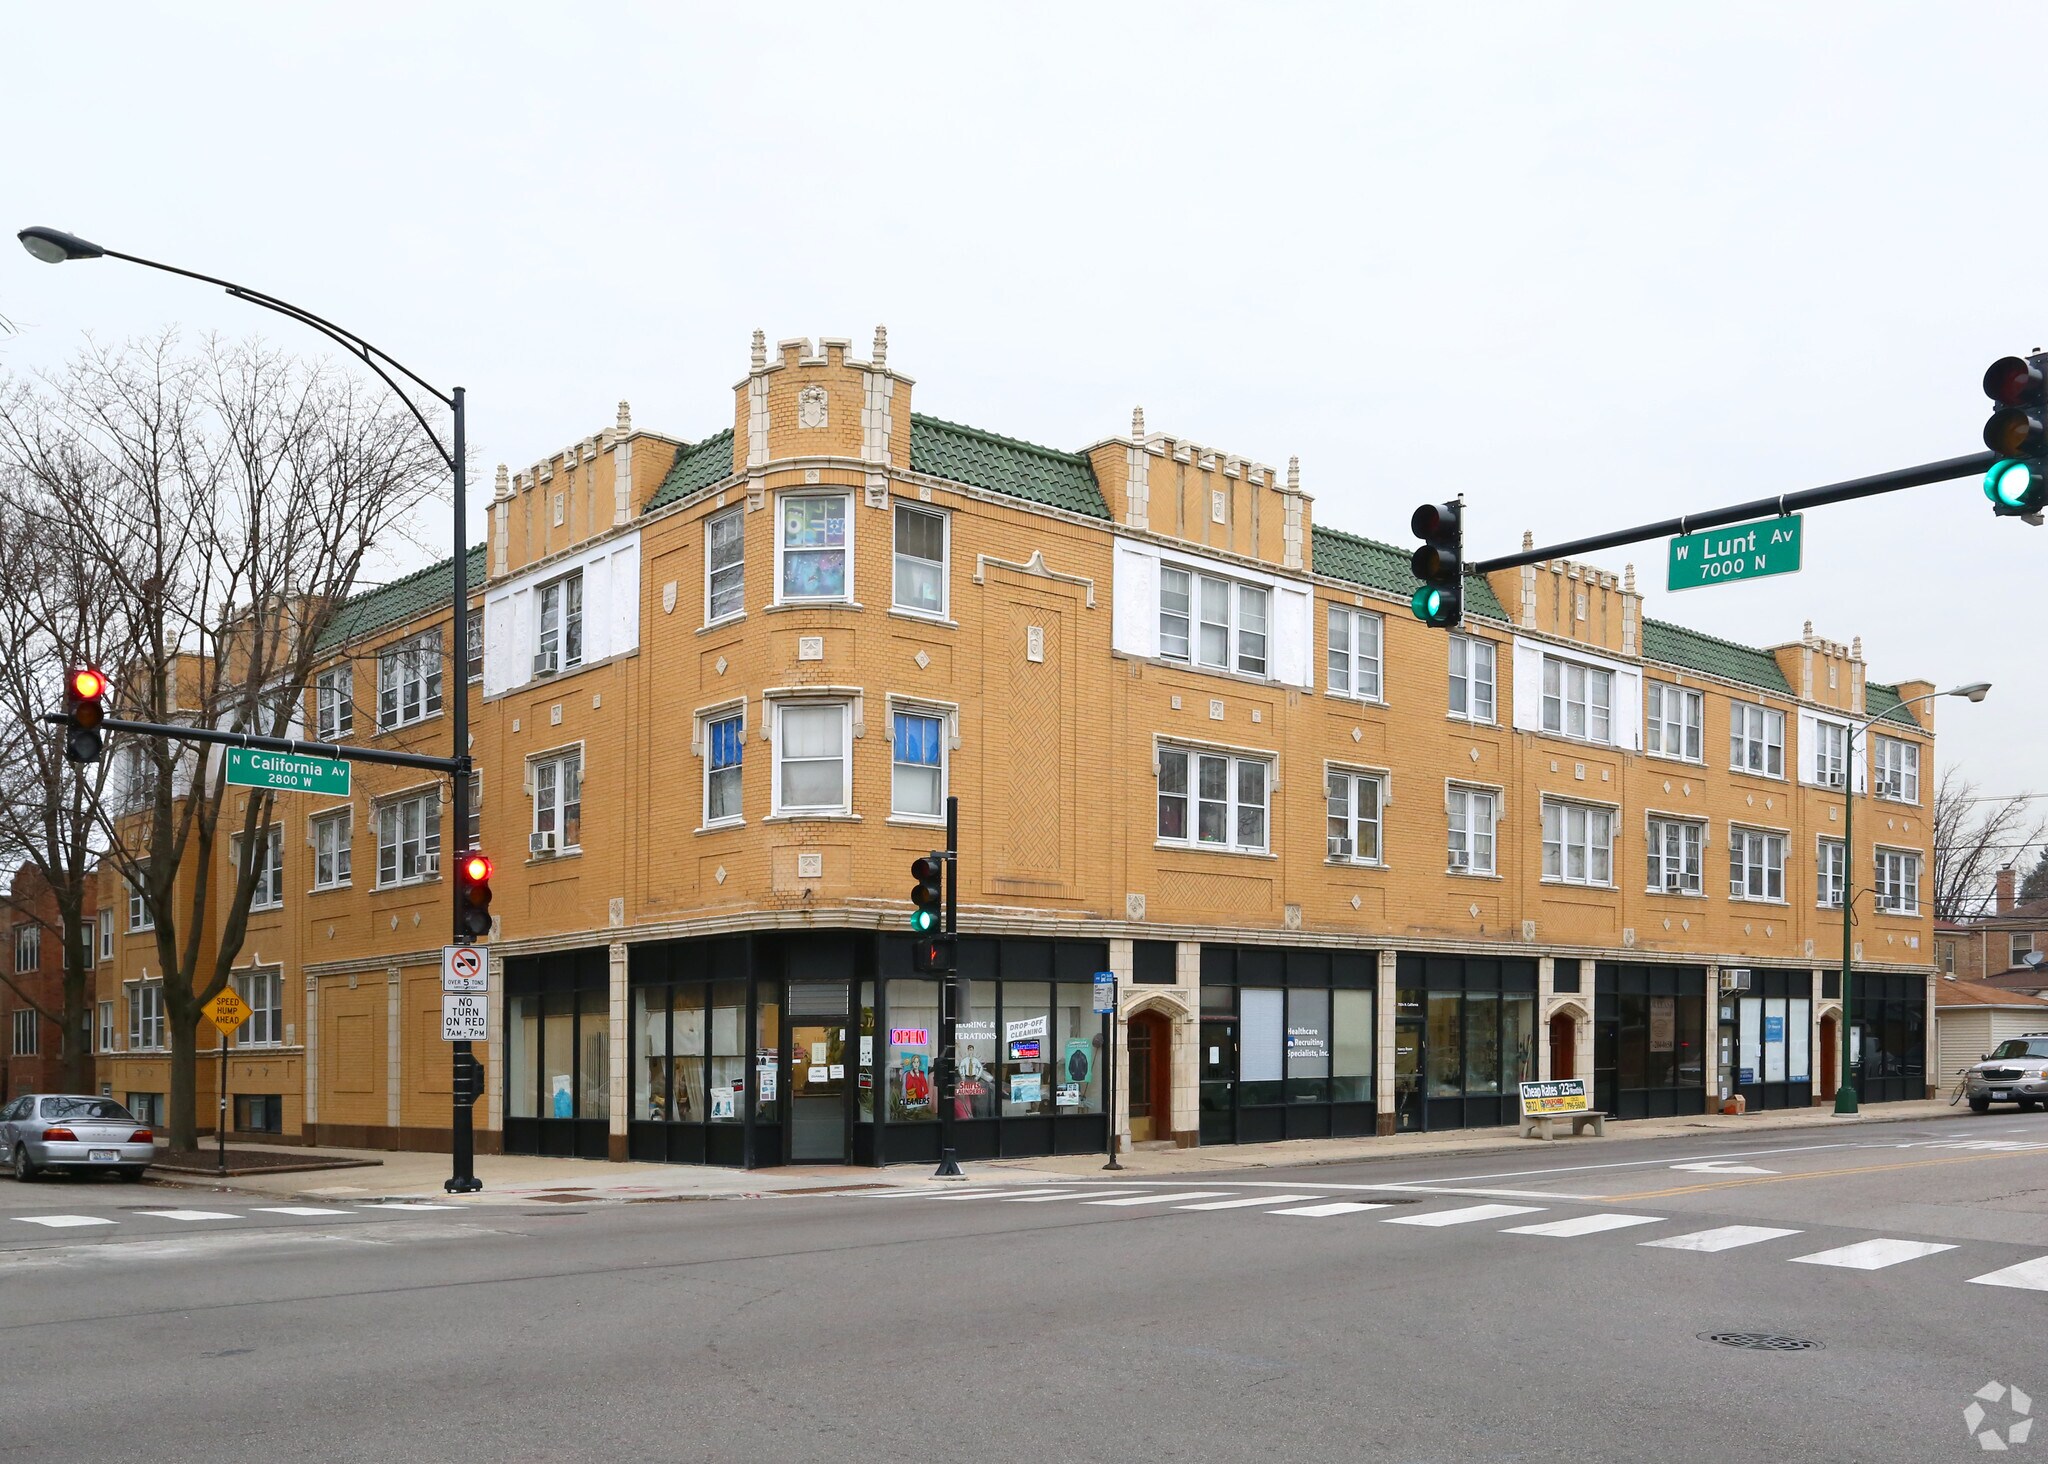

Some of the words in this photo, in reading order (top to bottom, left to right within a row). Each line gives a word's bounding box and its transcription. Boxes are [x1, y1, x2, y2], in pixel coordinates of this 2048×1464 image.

[1677, 546, 1689, 560] W
[1704, 530, 1757, 559] Lunt
[1771, 529, 1793, 544] Av
[1700, 559, 1745, 579] 7000
[1755, 555, 1766, 570] N
[233, 755, 240, 764] N
[251, 755, 322, 776] California
[332, 767, 345, 776] Av
[268, 774, 298, 785] 2800
[303, 777, 312, 787] W
[216, 998, 240, 1006] SPEED
[459, 998, 472, 1007] NO
[452, 1007, 479, 1016] TURN
[216, 1016, 239, 1024] AHEAD
[446, 1017, 460, 1026] ON
[465, 1018, 485, 1026] RED
[956, 1021, 987, 1029] ILORING
[990, 1021, 996, 1029] &
[1010, 1019, 1043, 1031] DROP-OFF
[446, 1028, 462, 1036] 7AM
[469, 1028, 485, 1036] 7PM
[1010, 1028, 1043, 1039] CLEANING
[1288, 1027, 1318, 1035] Healthcare
[893, 1030, 926, 1044] OPEN
[1295, 1038, 1324, 1047] Recruiting
[1288, 1049, 1318, 1059] Specialists,
[1319, 1049, 1330, 1057] Inc.
[1523, 1085, 1541, 1099] Cheap
[1541, 1084, 1558, 1096] Rates
